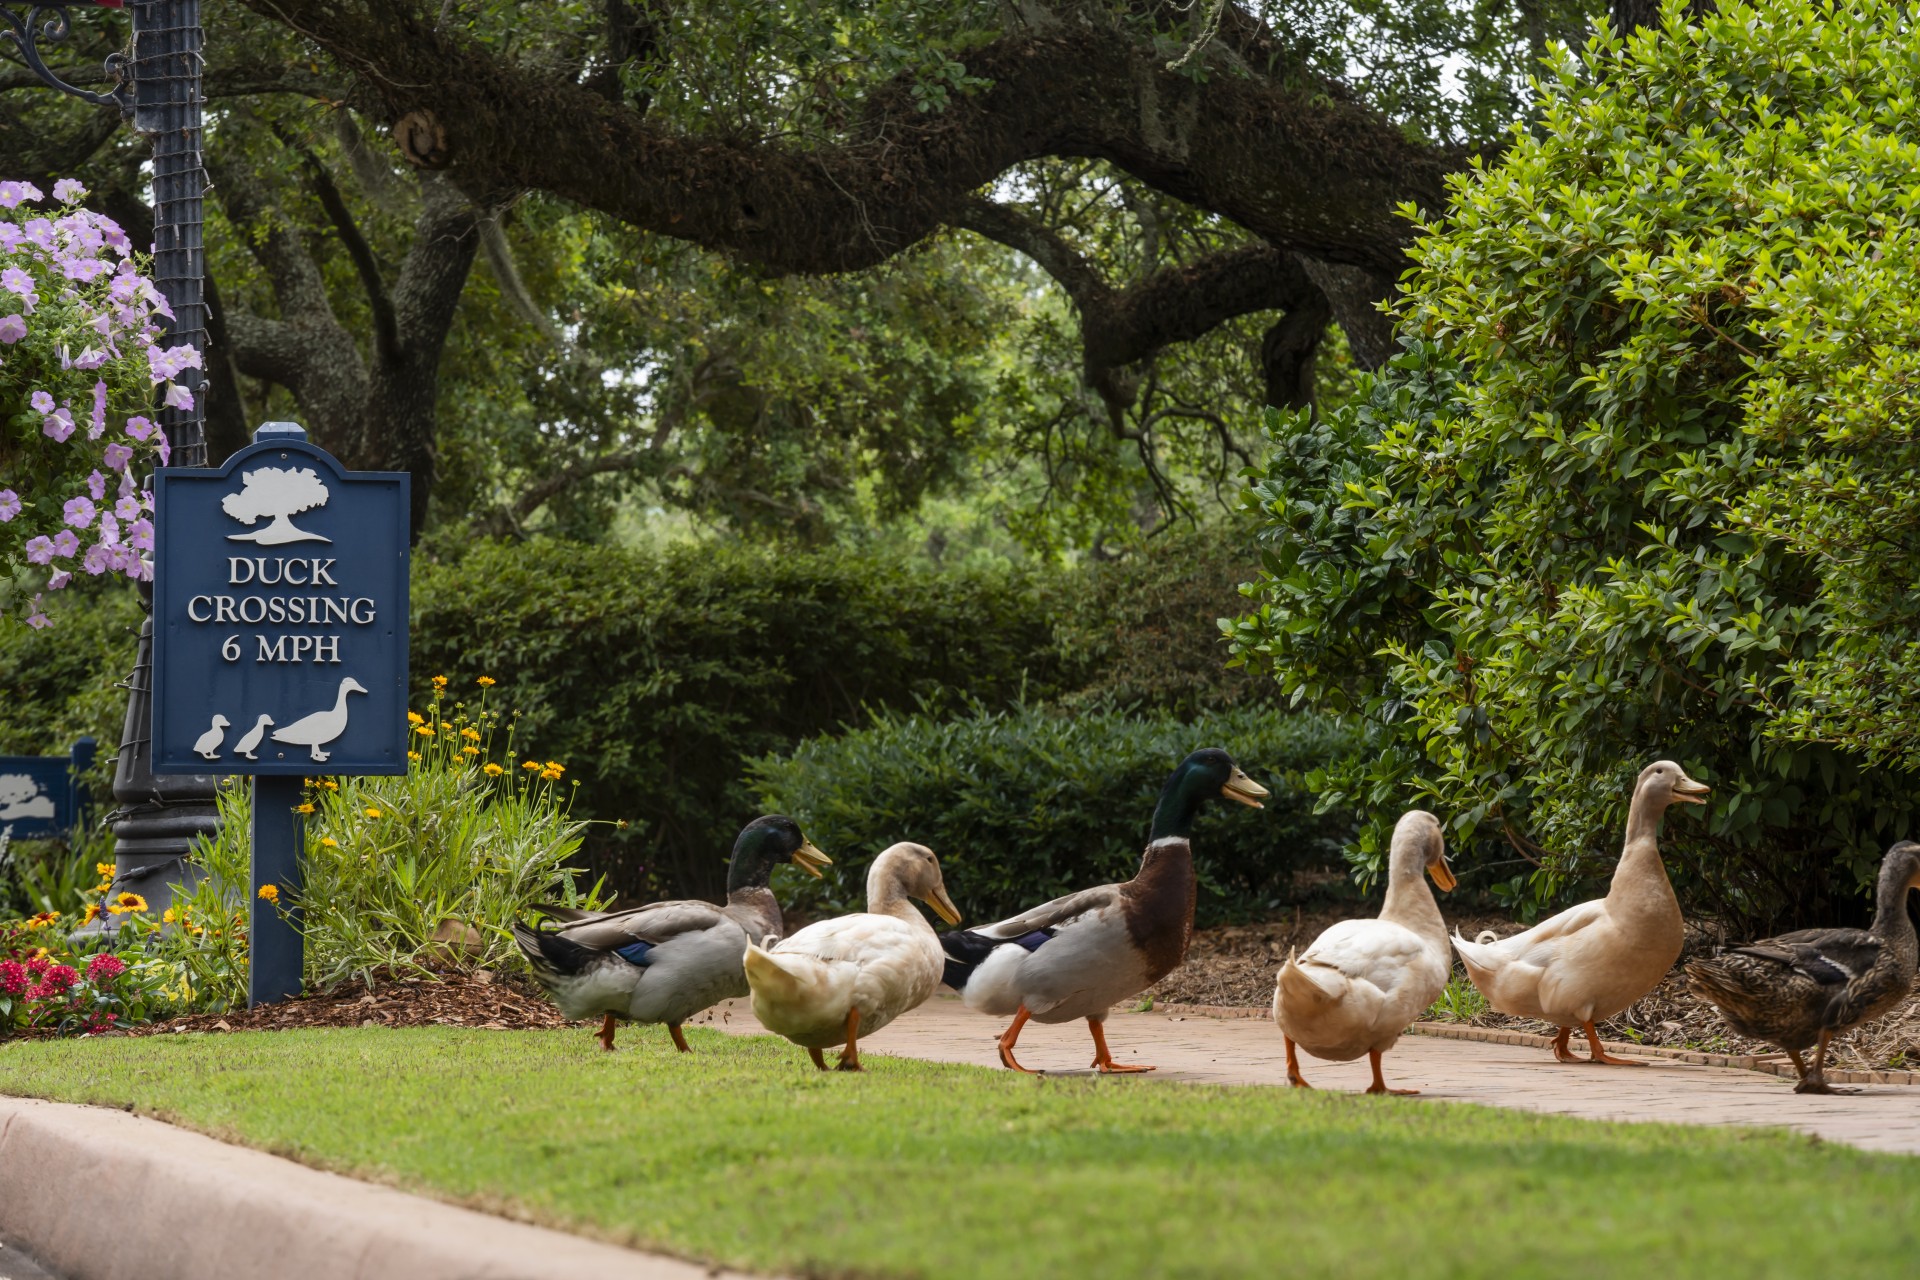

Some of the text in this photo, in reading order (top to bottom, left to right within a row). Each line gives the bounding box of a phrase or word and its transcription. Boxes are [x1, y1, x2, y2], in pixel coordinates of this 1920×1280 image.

[228, 557, 338, 585] DUCK
[187, 595, 376, 624] CROSSING
[221, 634, 342, 662] 6 MPH
